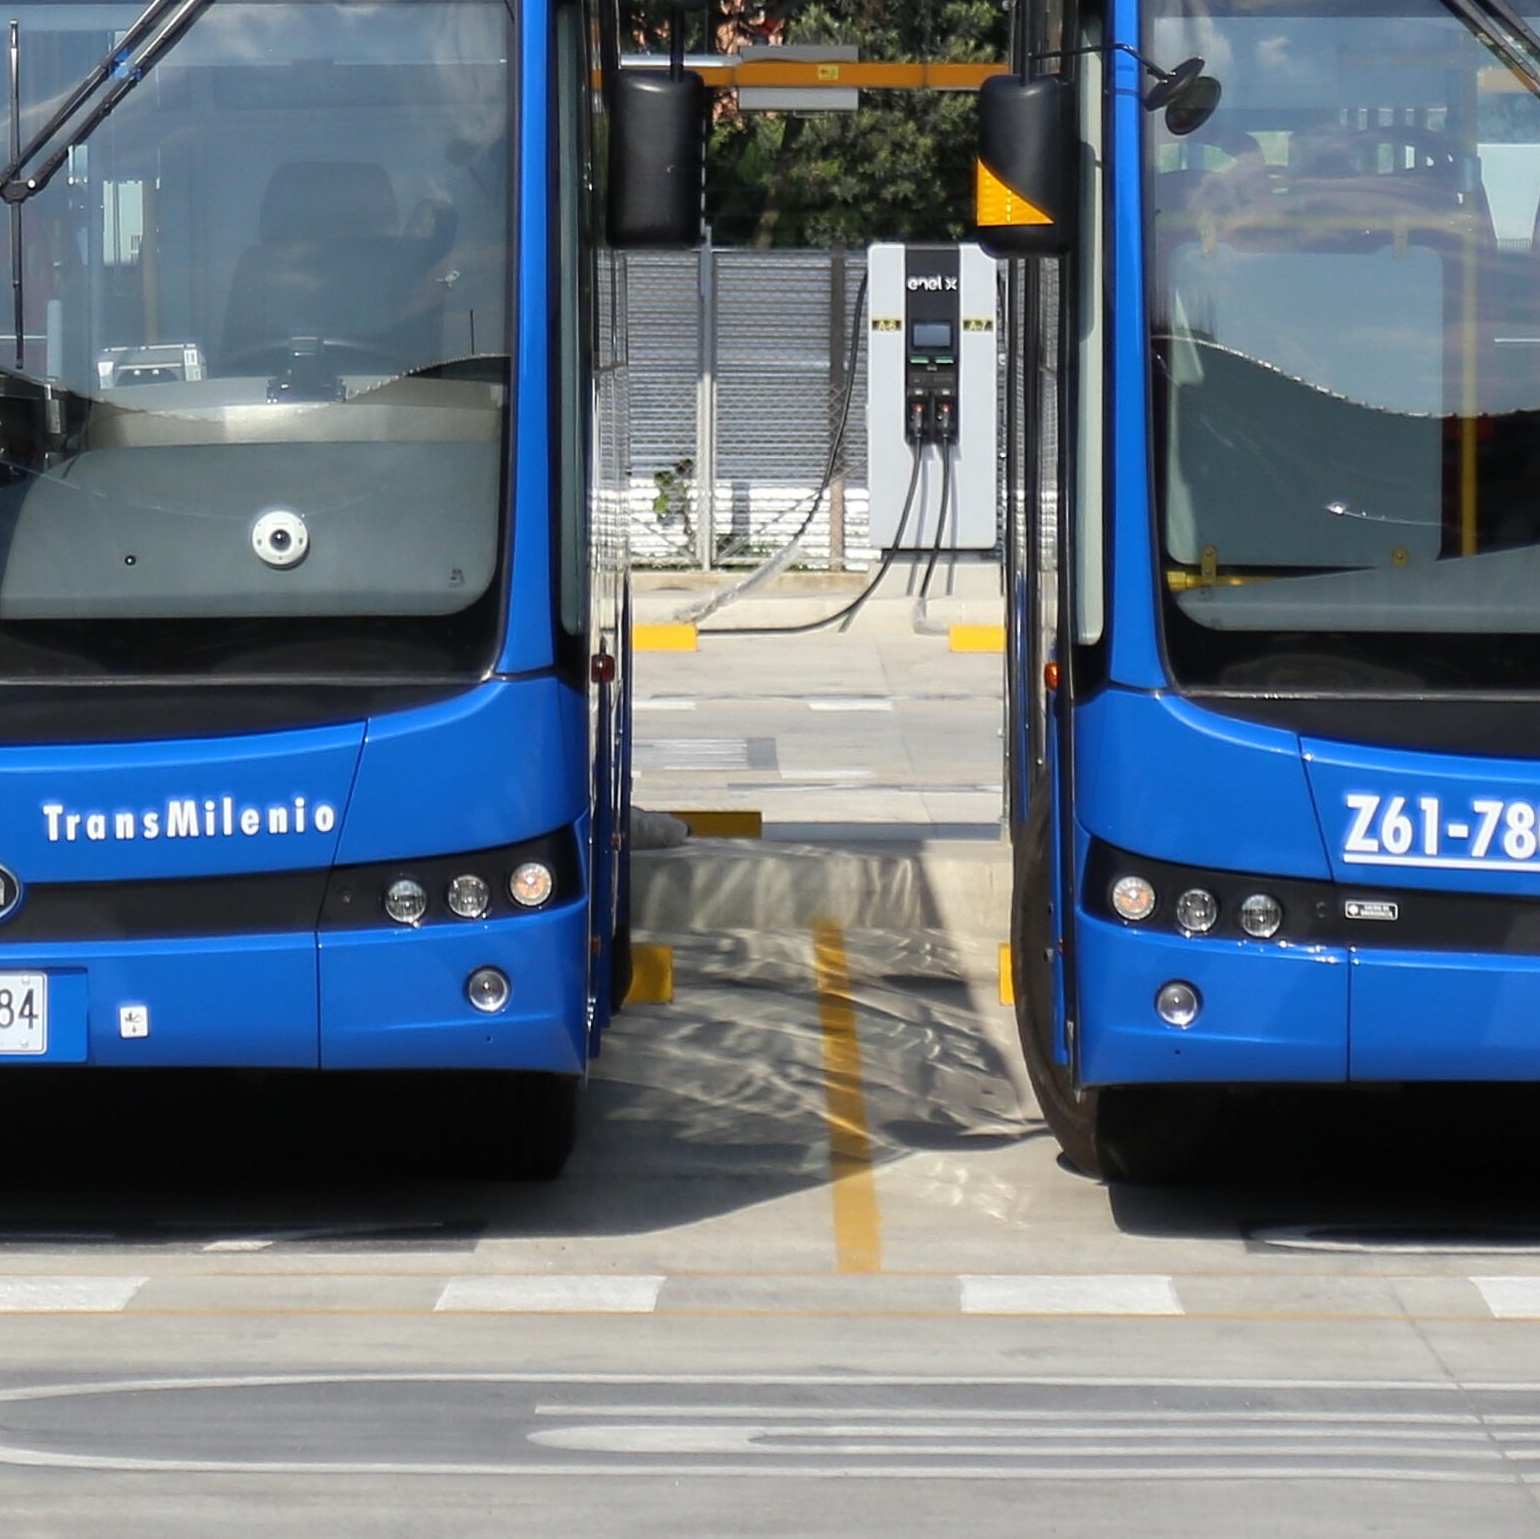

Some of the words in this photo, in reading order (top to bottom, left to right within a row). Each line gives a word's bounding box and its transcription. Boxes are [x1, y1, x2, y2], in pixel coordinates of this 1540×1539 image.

[907, 274, 942, 291] enel
[945, 276, 957, 291] x
[43, 796, 335, 841] TransMilenio
